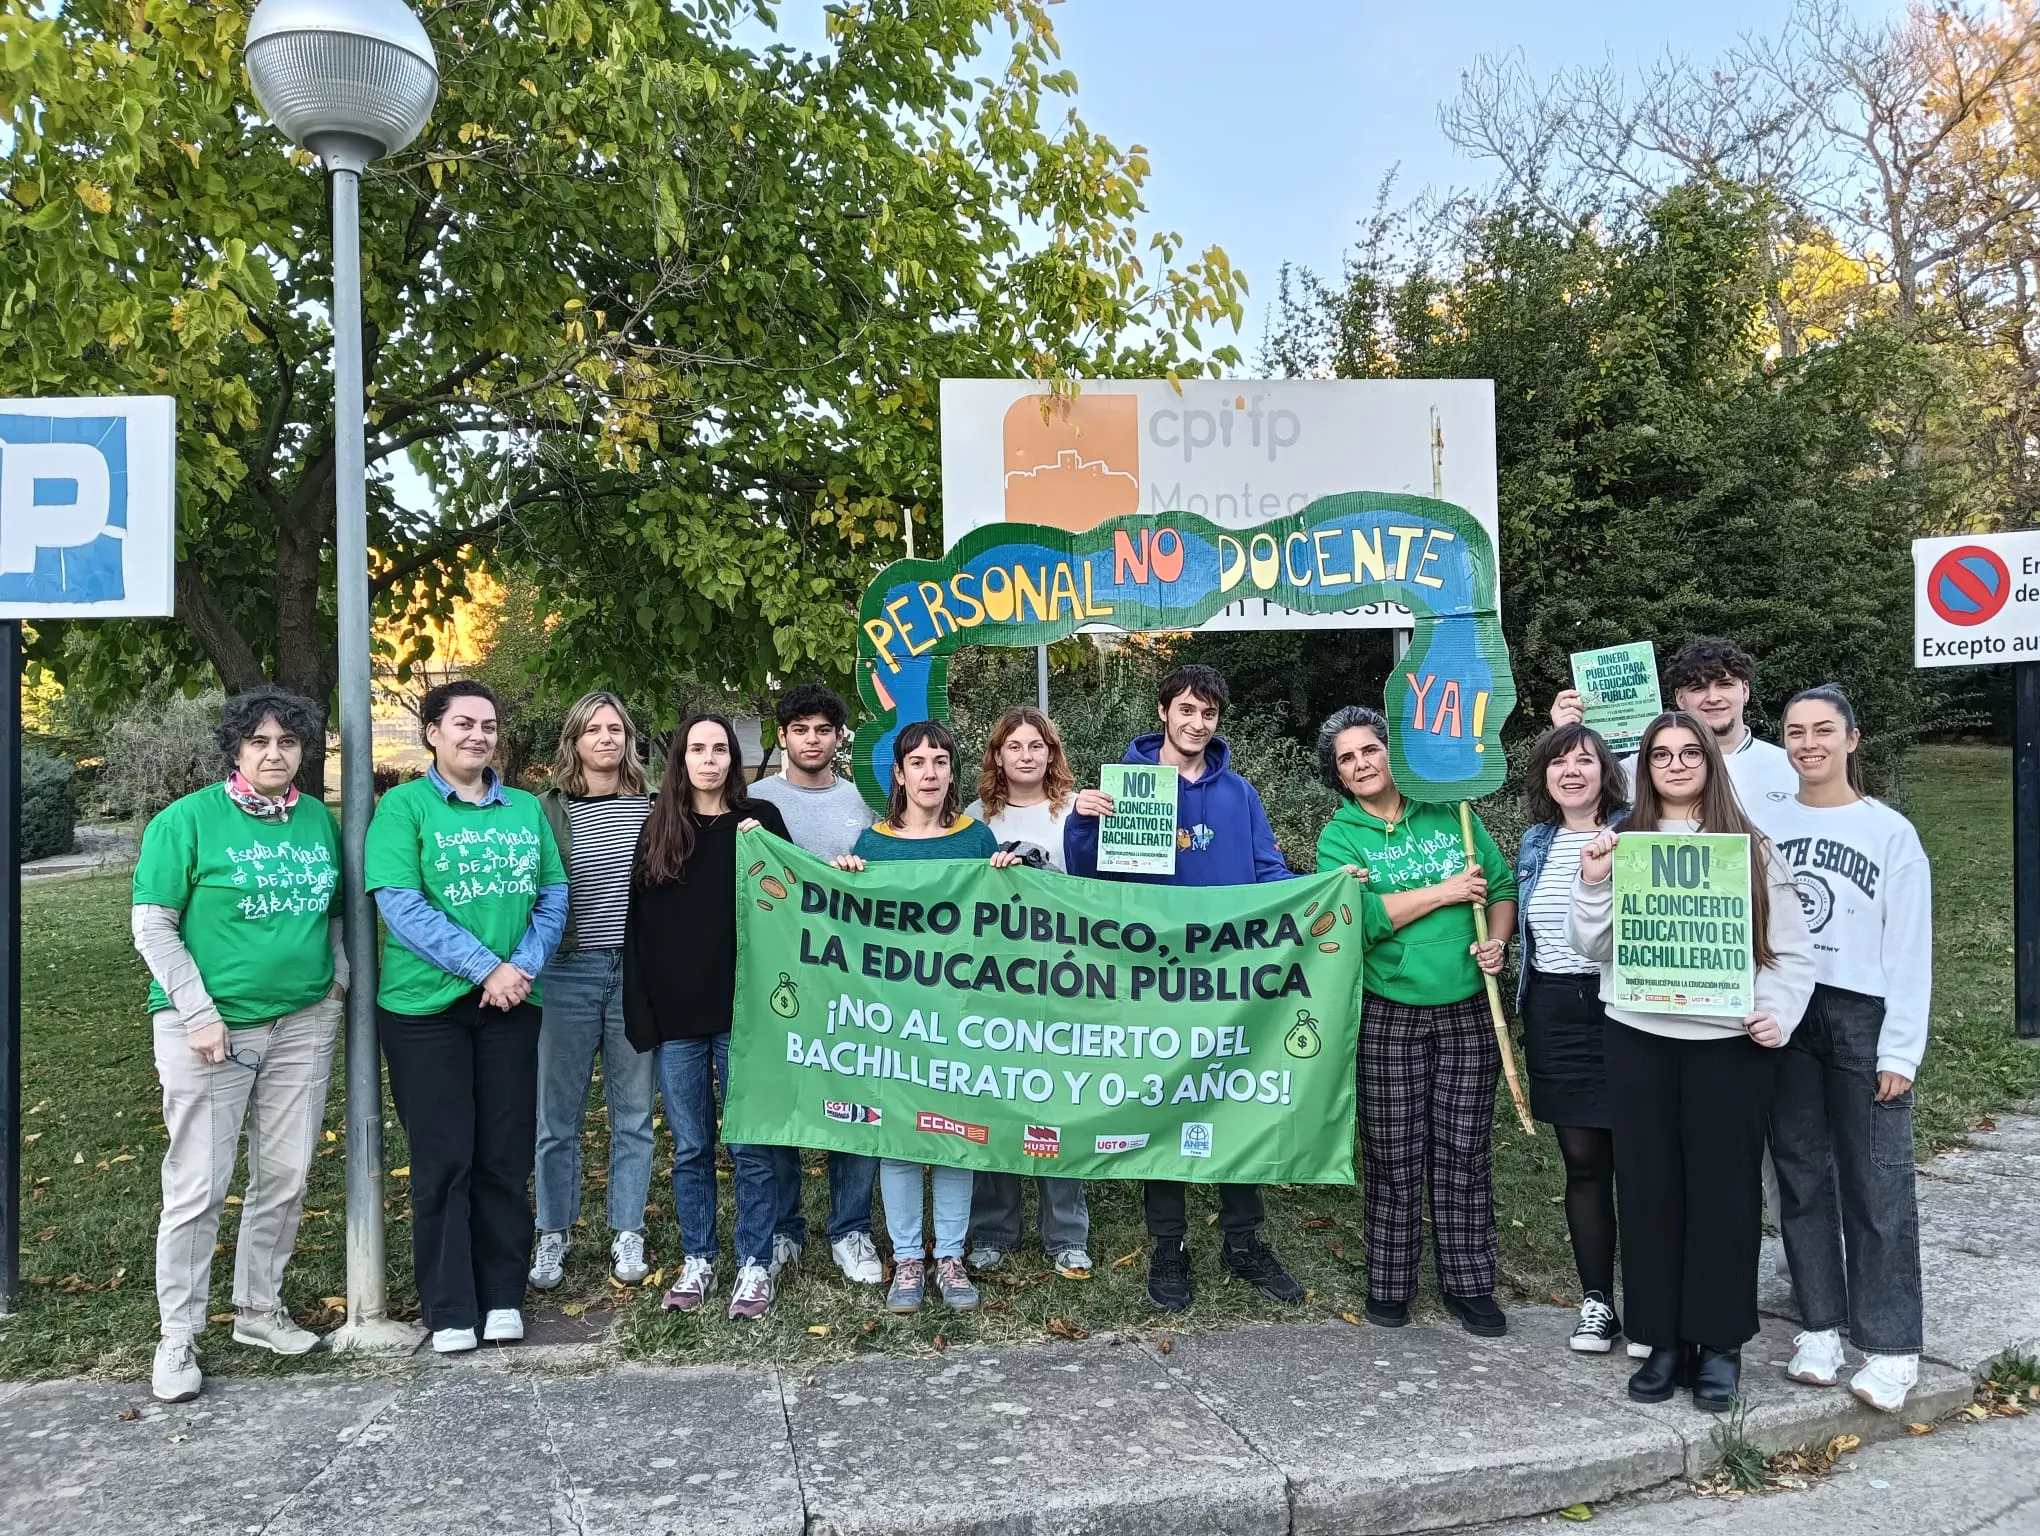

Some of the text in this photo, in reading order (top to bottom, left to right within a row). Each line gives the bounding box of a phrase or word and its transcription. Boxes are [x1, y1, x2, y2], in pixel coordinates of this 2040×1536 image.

[1, 443, 110, 574] P
[1112, 527, 1184, 585] NO
[1218, 526, 1455, 593] DOCENTE
[2015, 584, 2040, 602] de
[1597, 651, 1629, 666] DINERO
[1923, 636, 2040, 659] Excepto au
[1623, 661, 1646, 675] PARA
[1587, 681, 1598, 692] LA
[1406, 673, 1490, 753] YA!
[1123, 772, 1156, 798] NO!
[1118, 801, 1173, 816] CONCIERTO
[1104, 816, 1172, 831] EDUCATIVO EN
[1102, 831, 1172, 847] BACHILLERATO
[1651, 844, 1711, 889] NO!
[1813, 838, 1880, 900] SHORE
[1621, 893, 1744, 918] AL CONCIERTO
[800, 881, 1304, 957] DINERO PÚBLICO, PARA
[1621, 919, 1745, 944] EDUCATIVO EN
[1618, 944, 1746, 970] BACHILLERATO
[1814, 944, 1840, 952] DEMY
[800, 928, 1312, 1002] LA EDUCACIÓN PÚBLICA
[826, 993, 1251, 1060] ¡NO AL CONCIERTO DEL
[786, 1031, 1292, 1107] BACHILLERATO Y 0-3 AÑOS!
[826, 1101, 848, 1112] CGT
[920, 1116, 966, 1135] CCOO
[1024, 1142, 1059, 1152] HUSTE
[1097, 1140, 1118, 1150] UGT
[1183, 1141, 1209, 1150] ANPE
